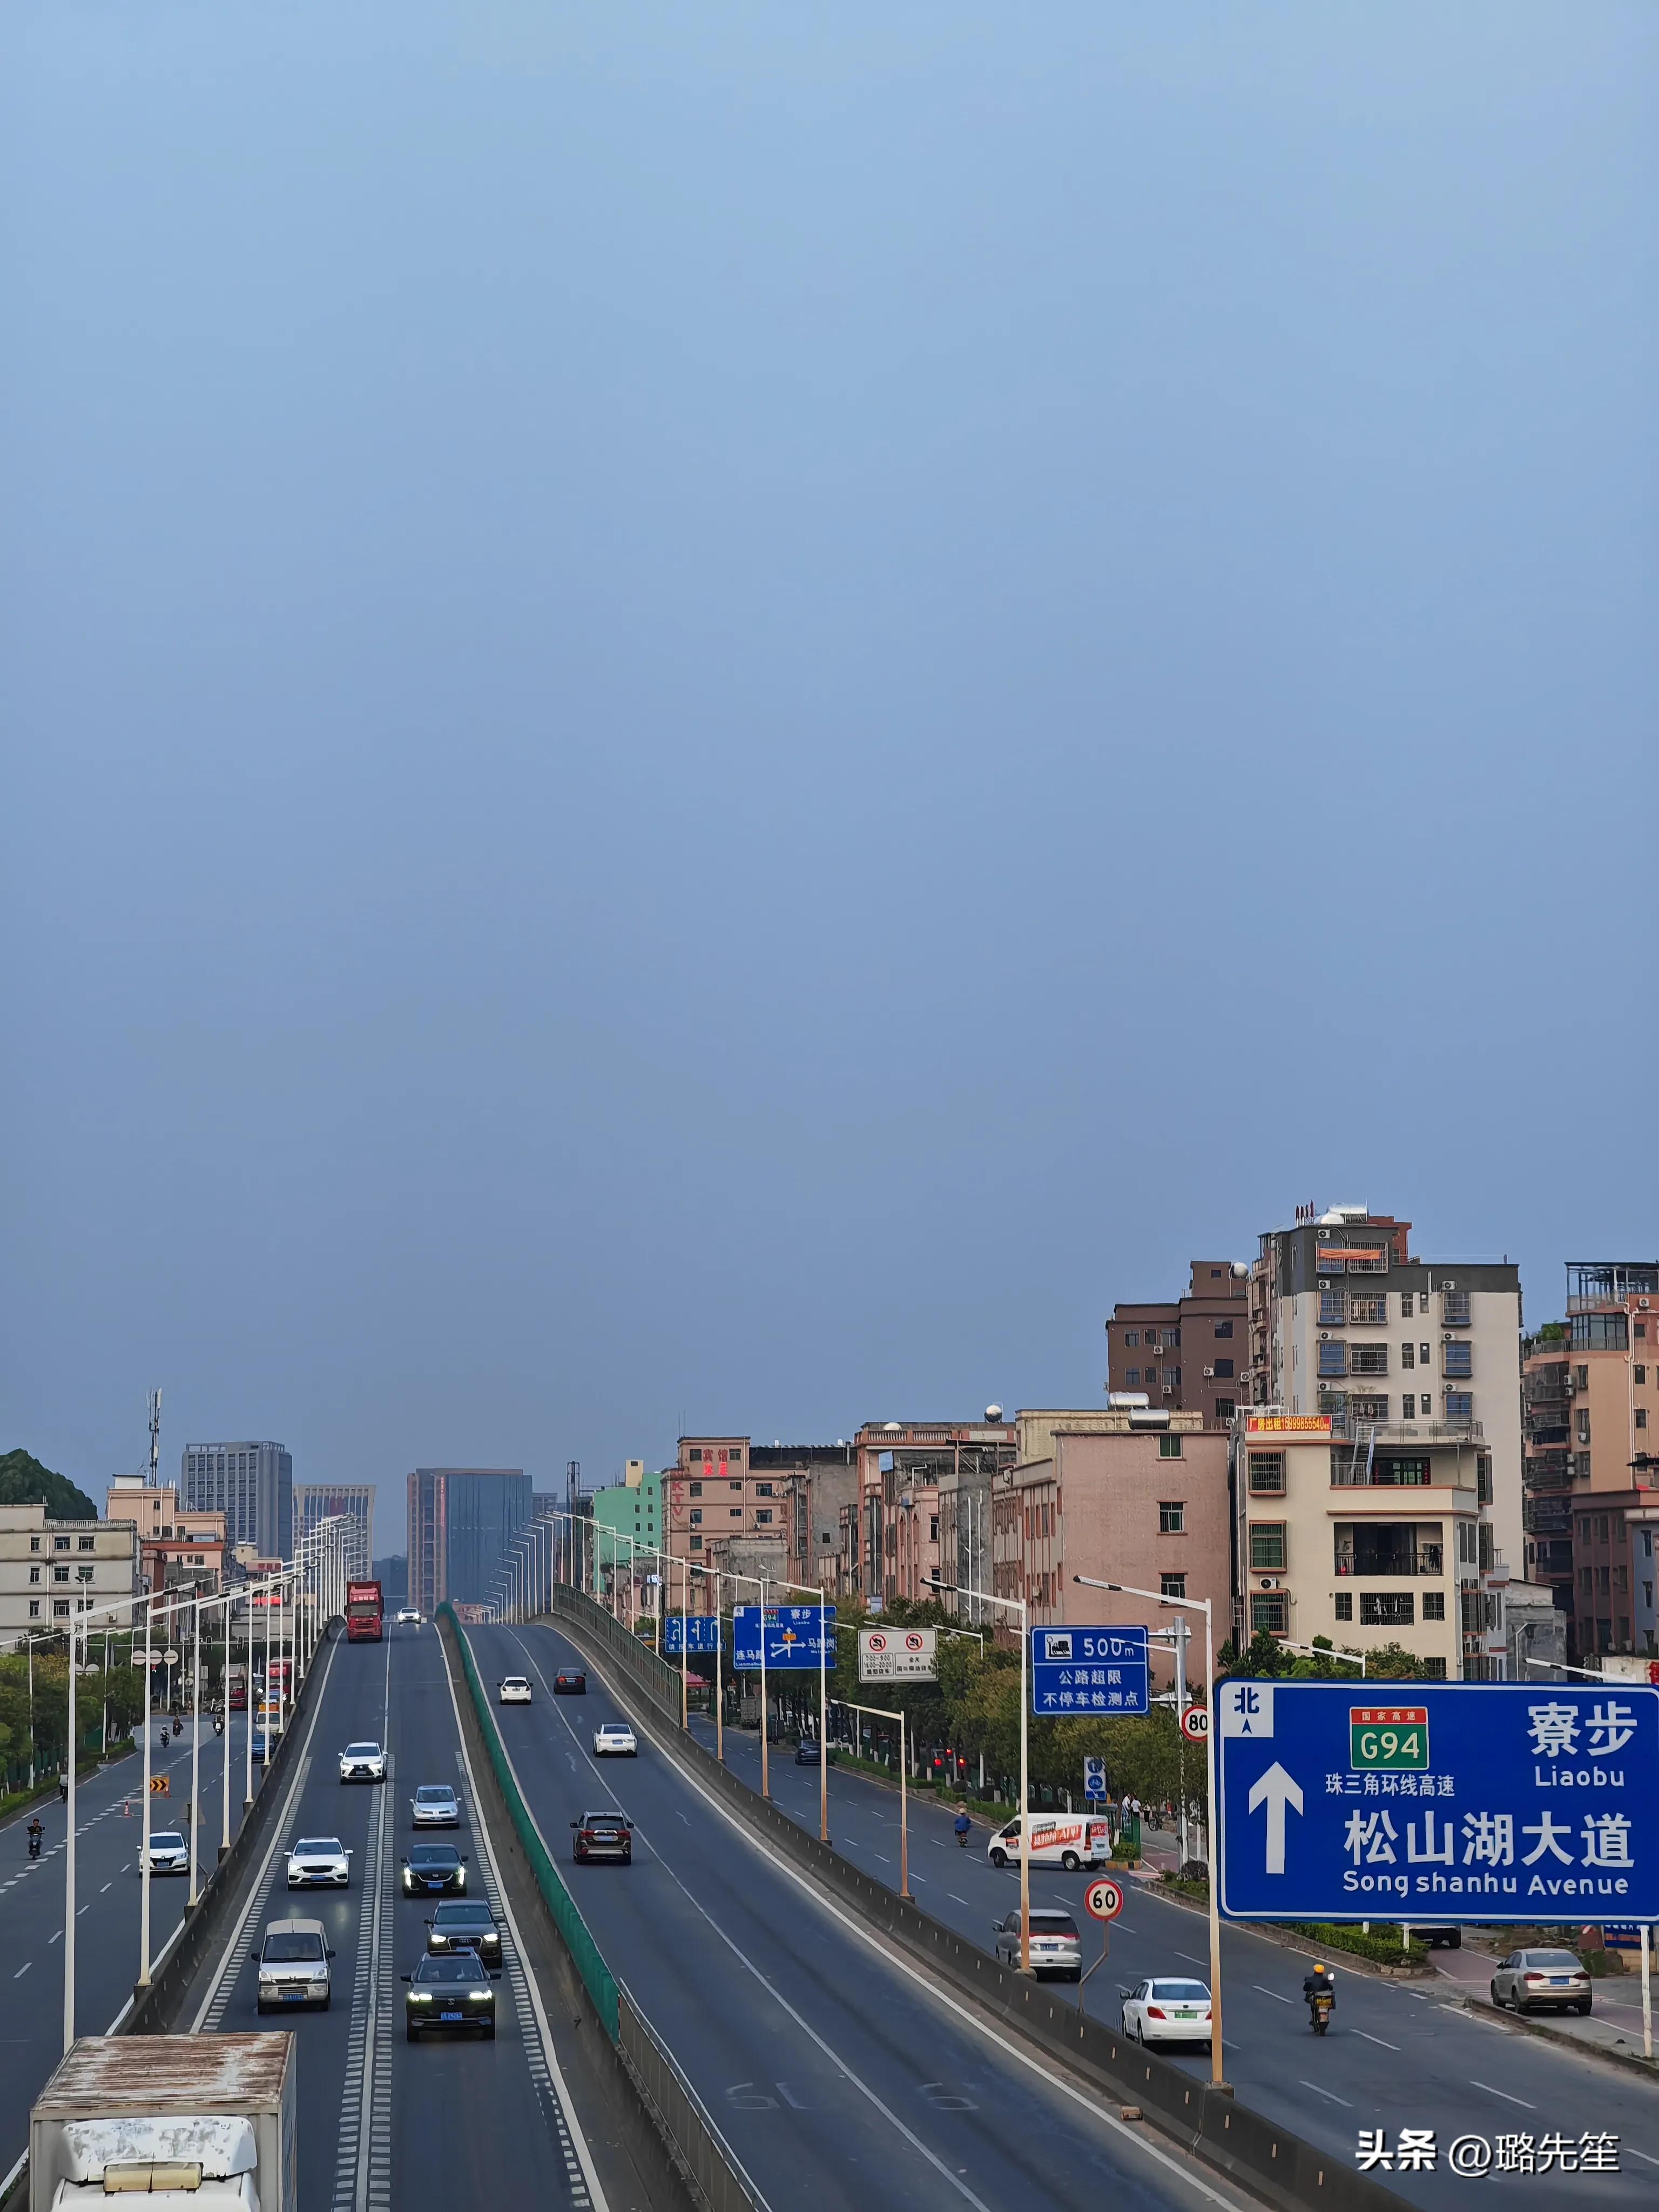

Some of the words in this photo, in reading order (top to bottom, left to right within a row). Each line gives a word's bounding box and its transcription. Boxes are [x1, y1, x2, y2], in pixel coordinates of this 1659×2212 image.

[672, 1481, 684, 1516] KTV
[1084, 1637, 1134, 1657] 500m
[1059, 1669, 1122, 1685] 公路超限
[1043, 1691, 1138, 1708] 不停车检测点
[1233, 1687, 1260, 1715] 北
[1189, 1714, 1208, 1731] 80
[1362, 1711, 1416, 1721] 国家高速
[1527, 1701, 1638, 1758] 寮步
[1361, 1732, 1420, 1759] G94
[1325, 1772, 1455, 1797] 珠三角环线高速
[1535, 1765, 1624, 1786] Liaobu
[1344, 1809, 1634, 1867] 松山湖大道
[1528, 1874, 1628, 1896] Avenue
[1093, 1890, 1115, 1908] 60
